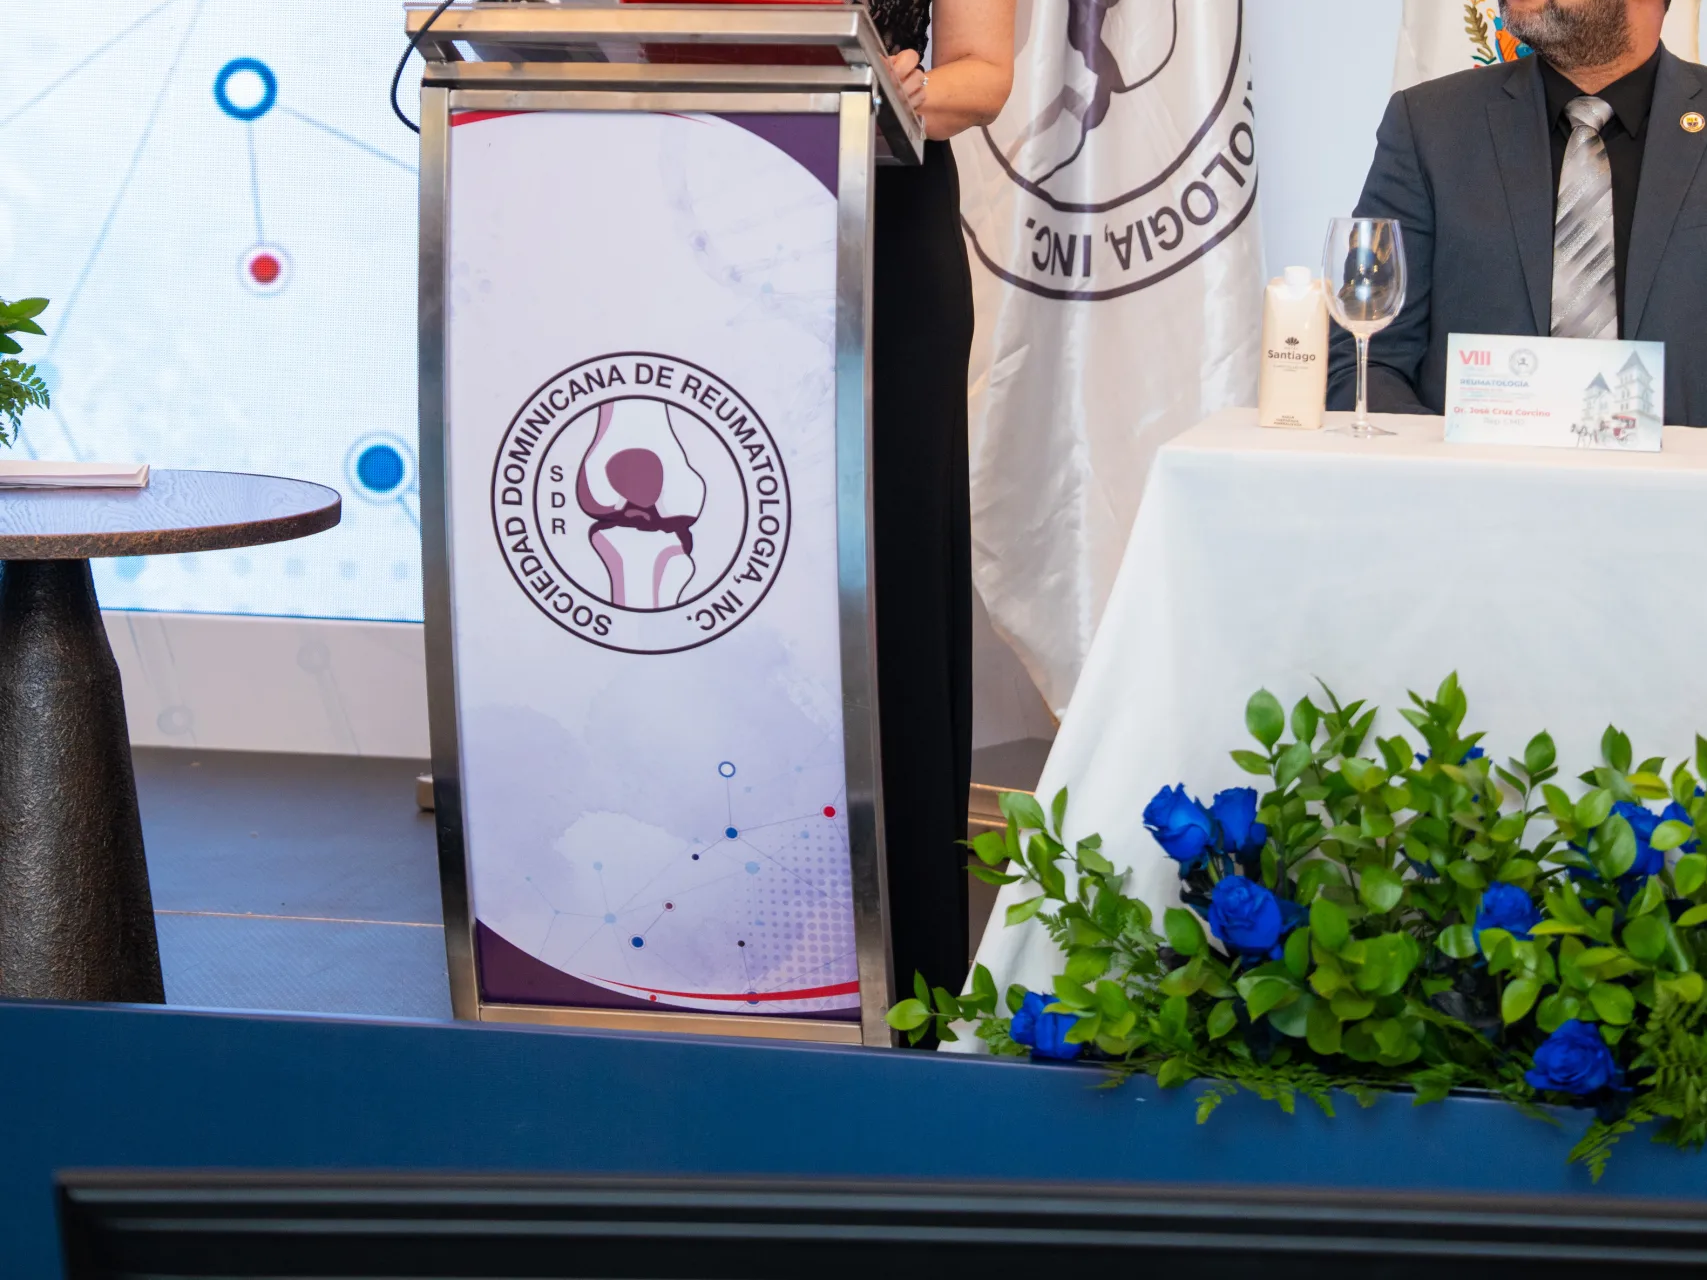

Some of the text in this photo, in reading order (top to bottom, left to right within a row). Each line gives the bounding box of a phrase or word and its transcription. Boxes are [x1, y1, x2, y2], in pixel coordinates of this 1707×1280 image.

[1025, 81, 1255, 278] OLOGIA, INC.
[1267, 349, 1316, 363] Santiago
[1458, 349, 1491, 366] VIII
[1453, 406, 1466, 414] Dr.
[1469, 406, 1490, 415] José
[1492, 407, 1513, 416] Cruz
[501, 362, 781, 636] SOCIEDAD DOMINICANA DE REUMATOLOGIA, INC.
